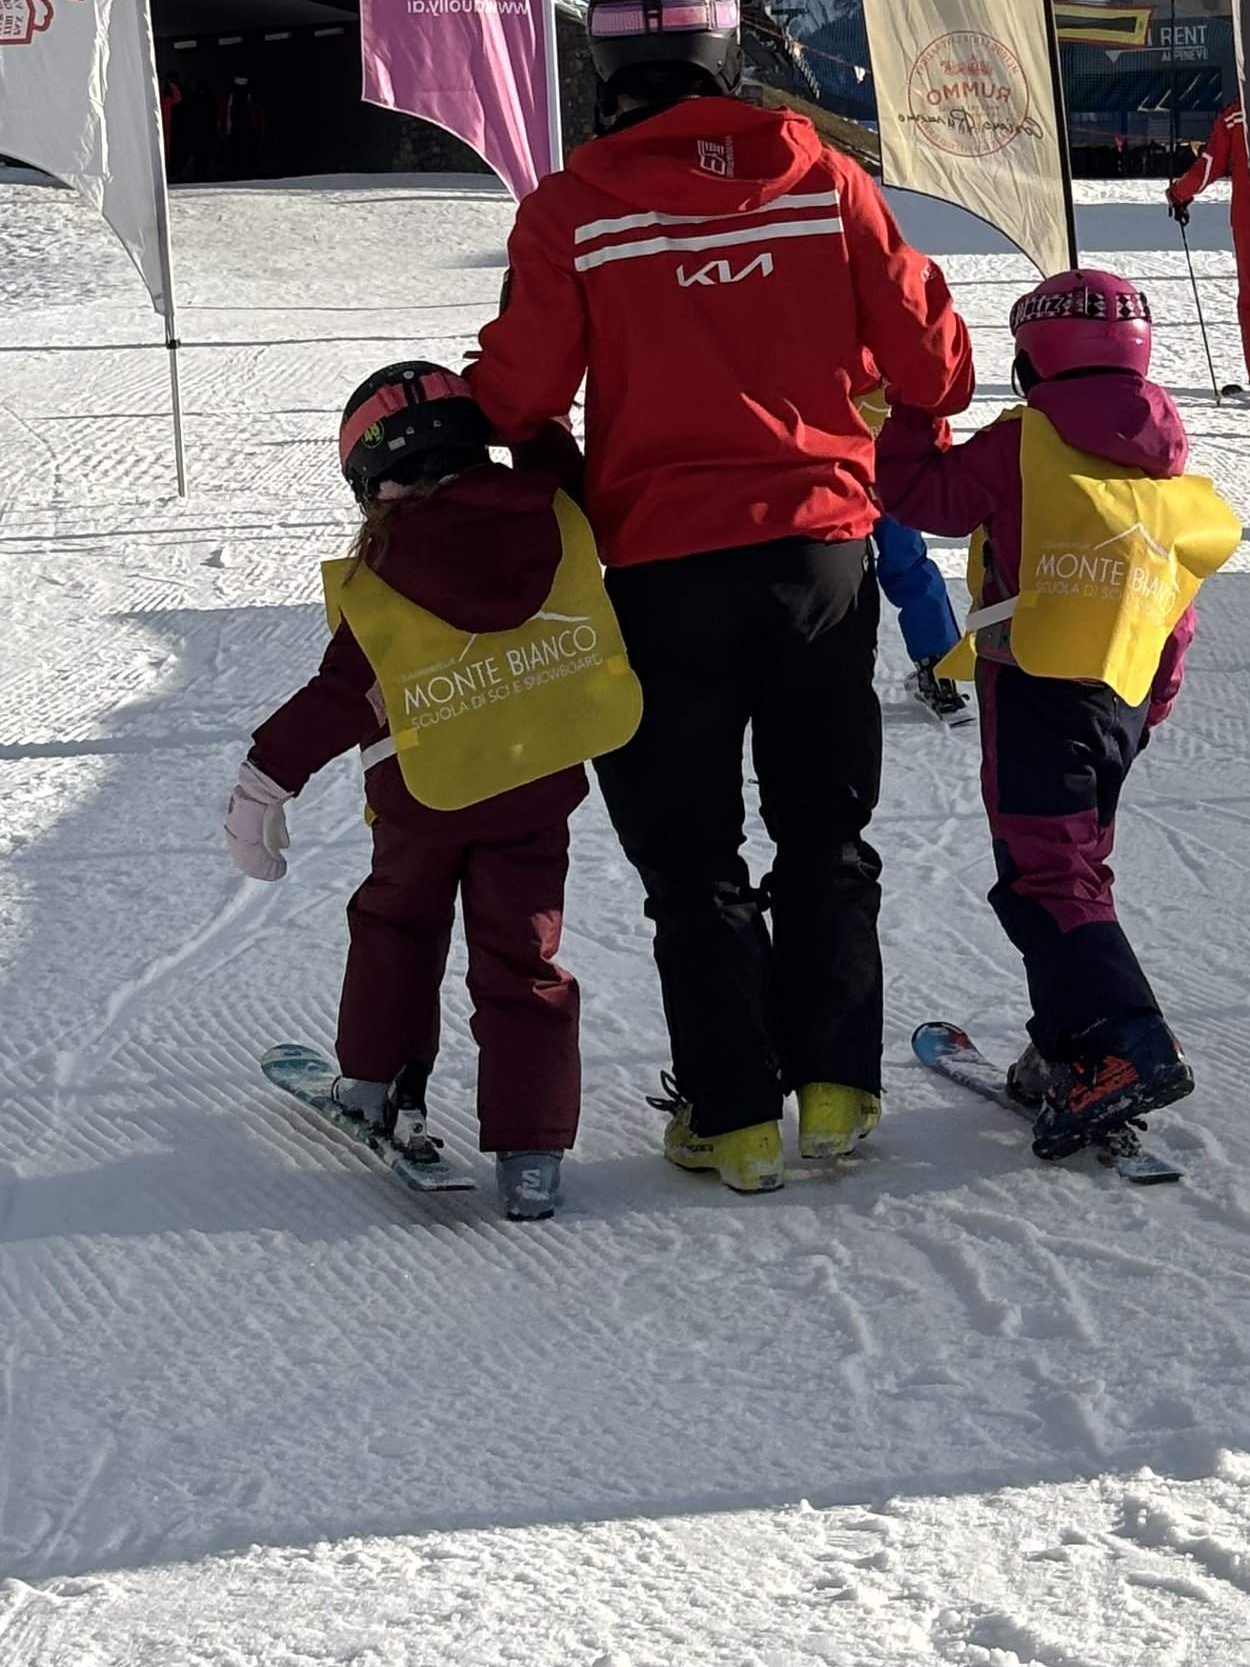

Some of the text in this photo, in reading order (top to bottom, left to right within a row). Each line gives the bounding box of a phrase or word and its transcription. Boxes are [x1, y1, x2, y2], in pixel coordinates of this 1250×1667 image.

[1160, 25, 1208, 47] RENT
[676, 252, 774, 287] KIA
[1034, 553, 1125, 586] MONTE
[1131, 566, 1177, 616] BIANO
[1034, 580, 1080, 596] SCUOLA
[1083, 583, 1098, 597] DI
[403, 657, 502, 715] MONTE
[505, 624, 597, 677] BIANCO
[411, 701, 468, 731] SCUOLA
[470, 694, 487, 710] DI
[488, 685, 511, 704] SCI
[511, 679, 522, 695] E
